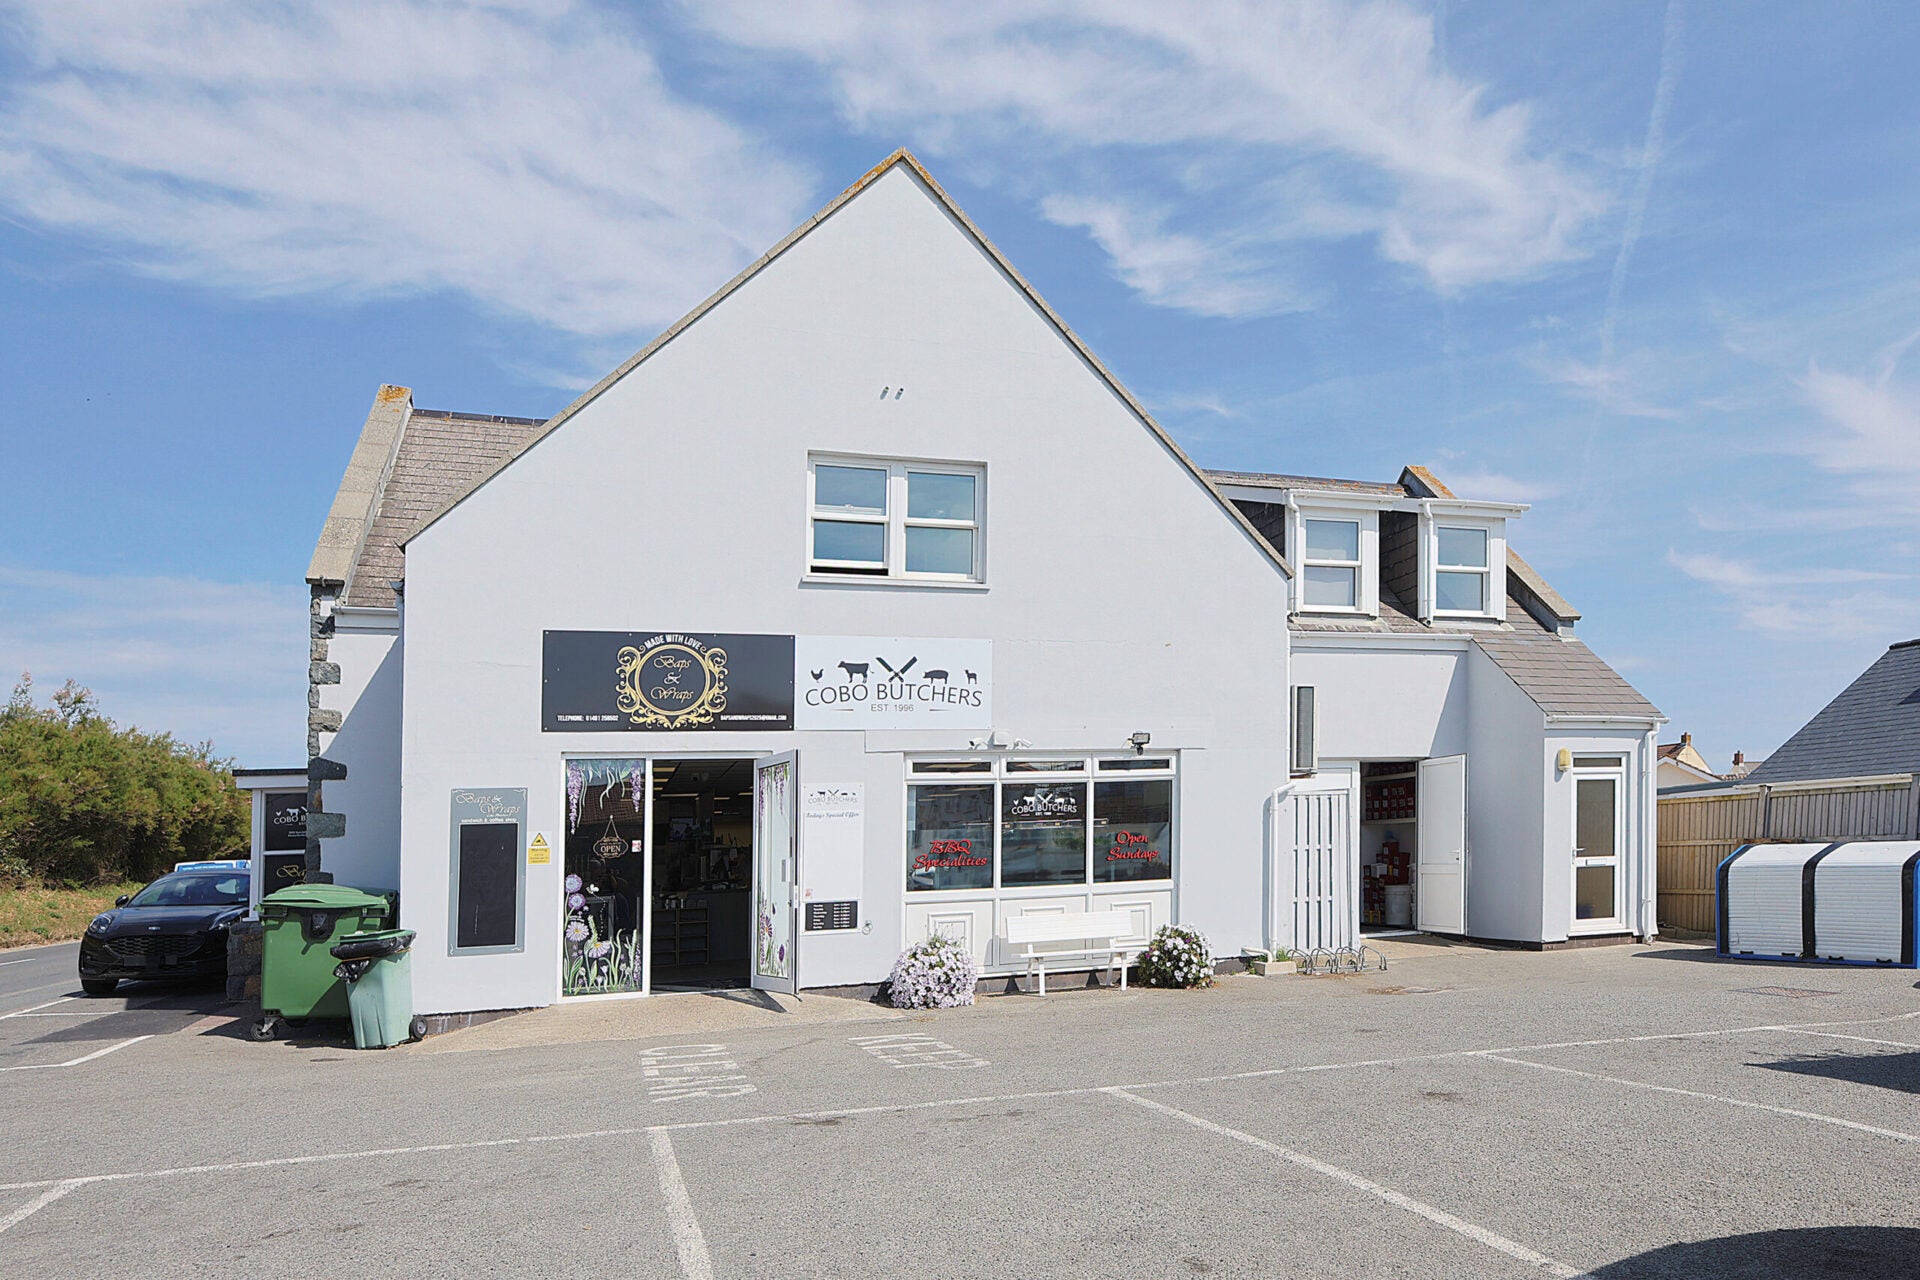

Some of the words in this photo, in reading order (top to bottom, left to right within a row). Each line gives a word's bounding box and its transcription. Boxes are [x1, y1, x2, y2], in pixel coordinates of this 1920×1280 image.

[644, 634, 665, 649] MADE
[665, 634, 684, 643] WITH
[684, 636, 702, 650] LOVE
[653, 655, 692, 673] Baps
[663, 672, 682, 684] &
[650, 686, 694, 704] Wraps
[805, 684, 869, 706] COBO
[876, 683, 983, 707] BUTCHERS
[894, 704, 914, 712] 1996
[456, 792, 490, 806] Baps
[480, 802, 520, 816] Wraps
[1012, 805, 1035, 815] COBO
[1037, 801, 1078, 813] BUTCHERS
[273, 815, 299, 825] COBO
[929, 838, 973, 855] BBQ
[1116, 830, 1149, 847] Open
[1107, 846, 1159, 862] Sundays
[912, 854, 988, 872] Specialities
[639, 1043, 758, 1102] CLEAR
